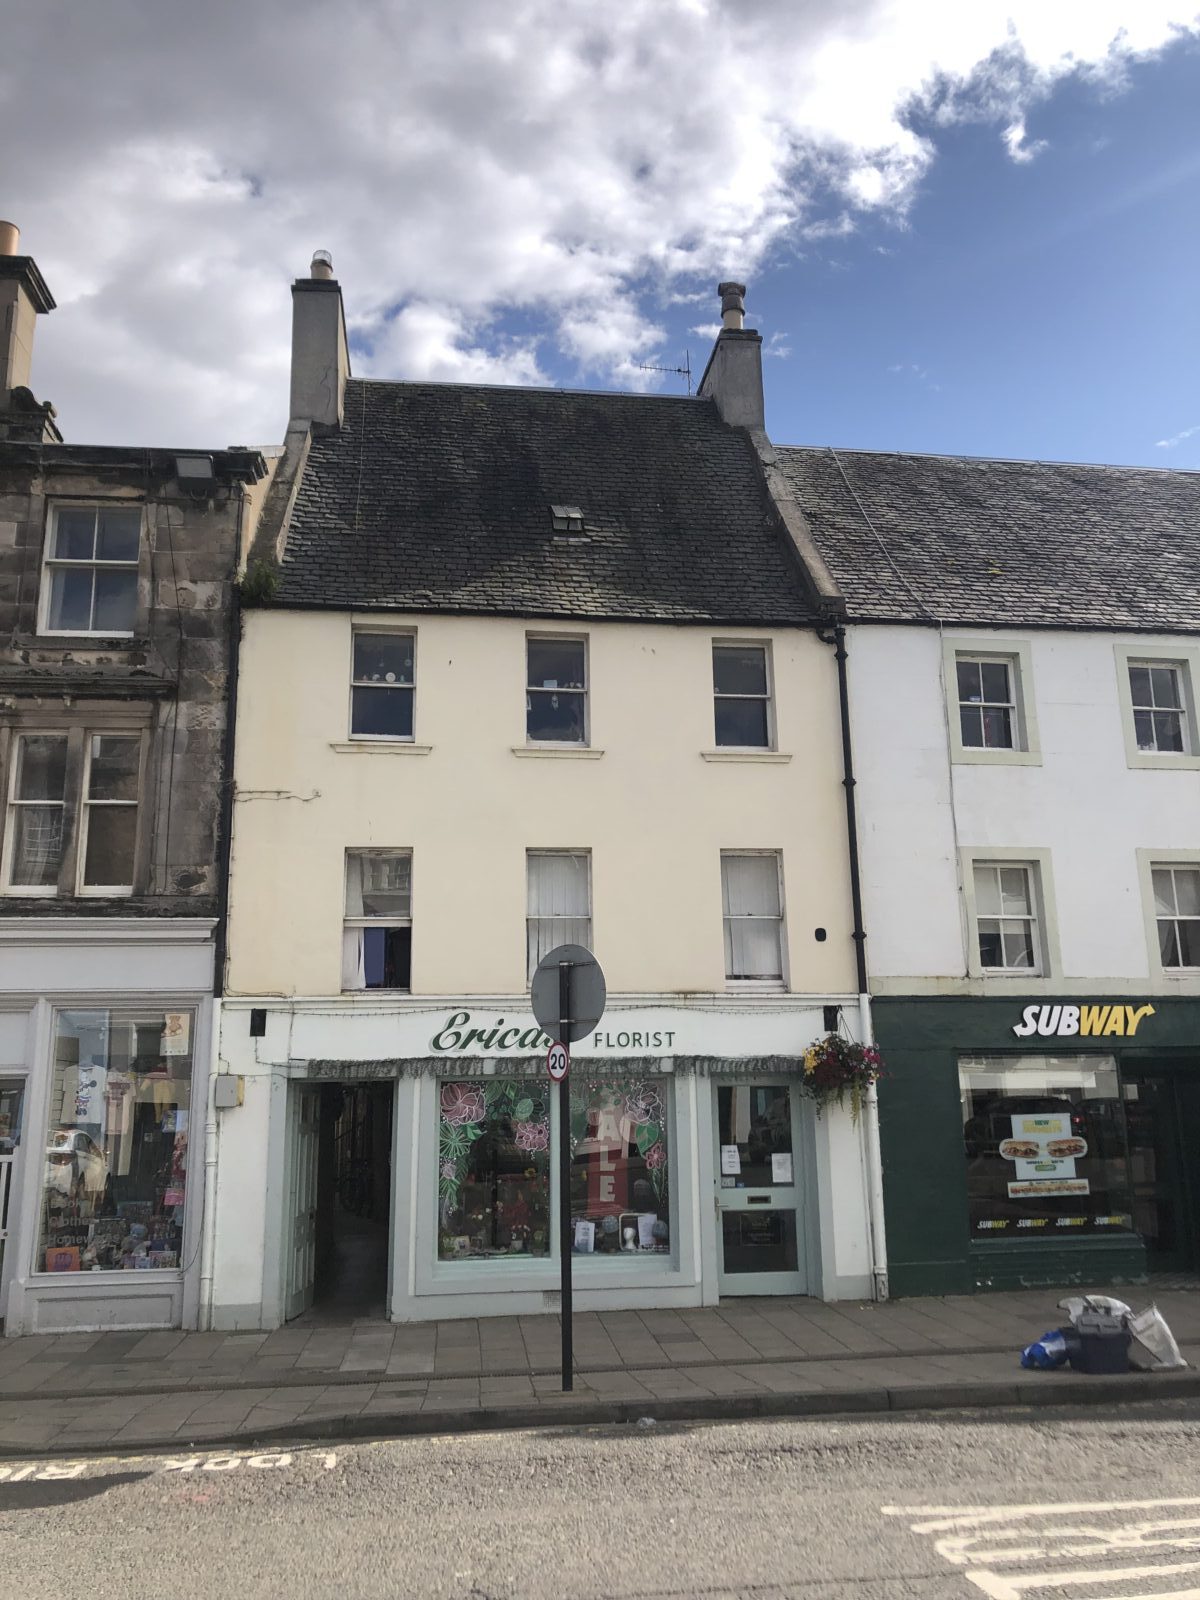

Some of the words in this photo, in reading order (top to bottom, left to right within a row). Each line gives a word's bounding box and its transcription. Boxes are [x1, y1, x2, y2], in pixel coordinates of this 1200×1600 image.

[1013, 1003, 1156, 1037] SUBWAY
[594, 1031, 676, 1048] FLORIST
[550, 1053, 566, 1070] 20
[162, 1453, 337, 1473] LOOK
